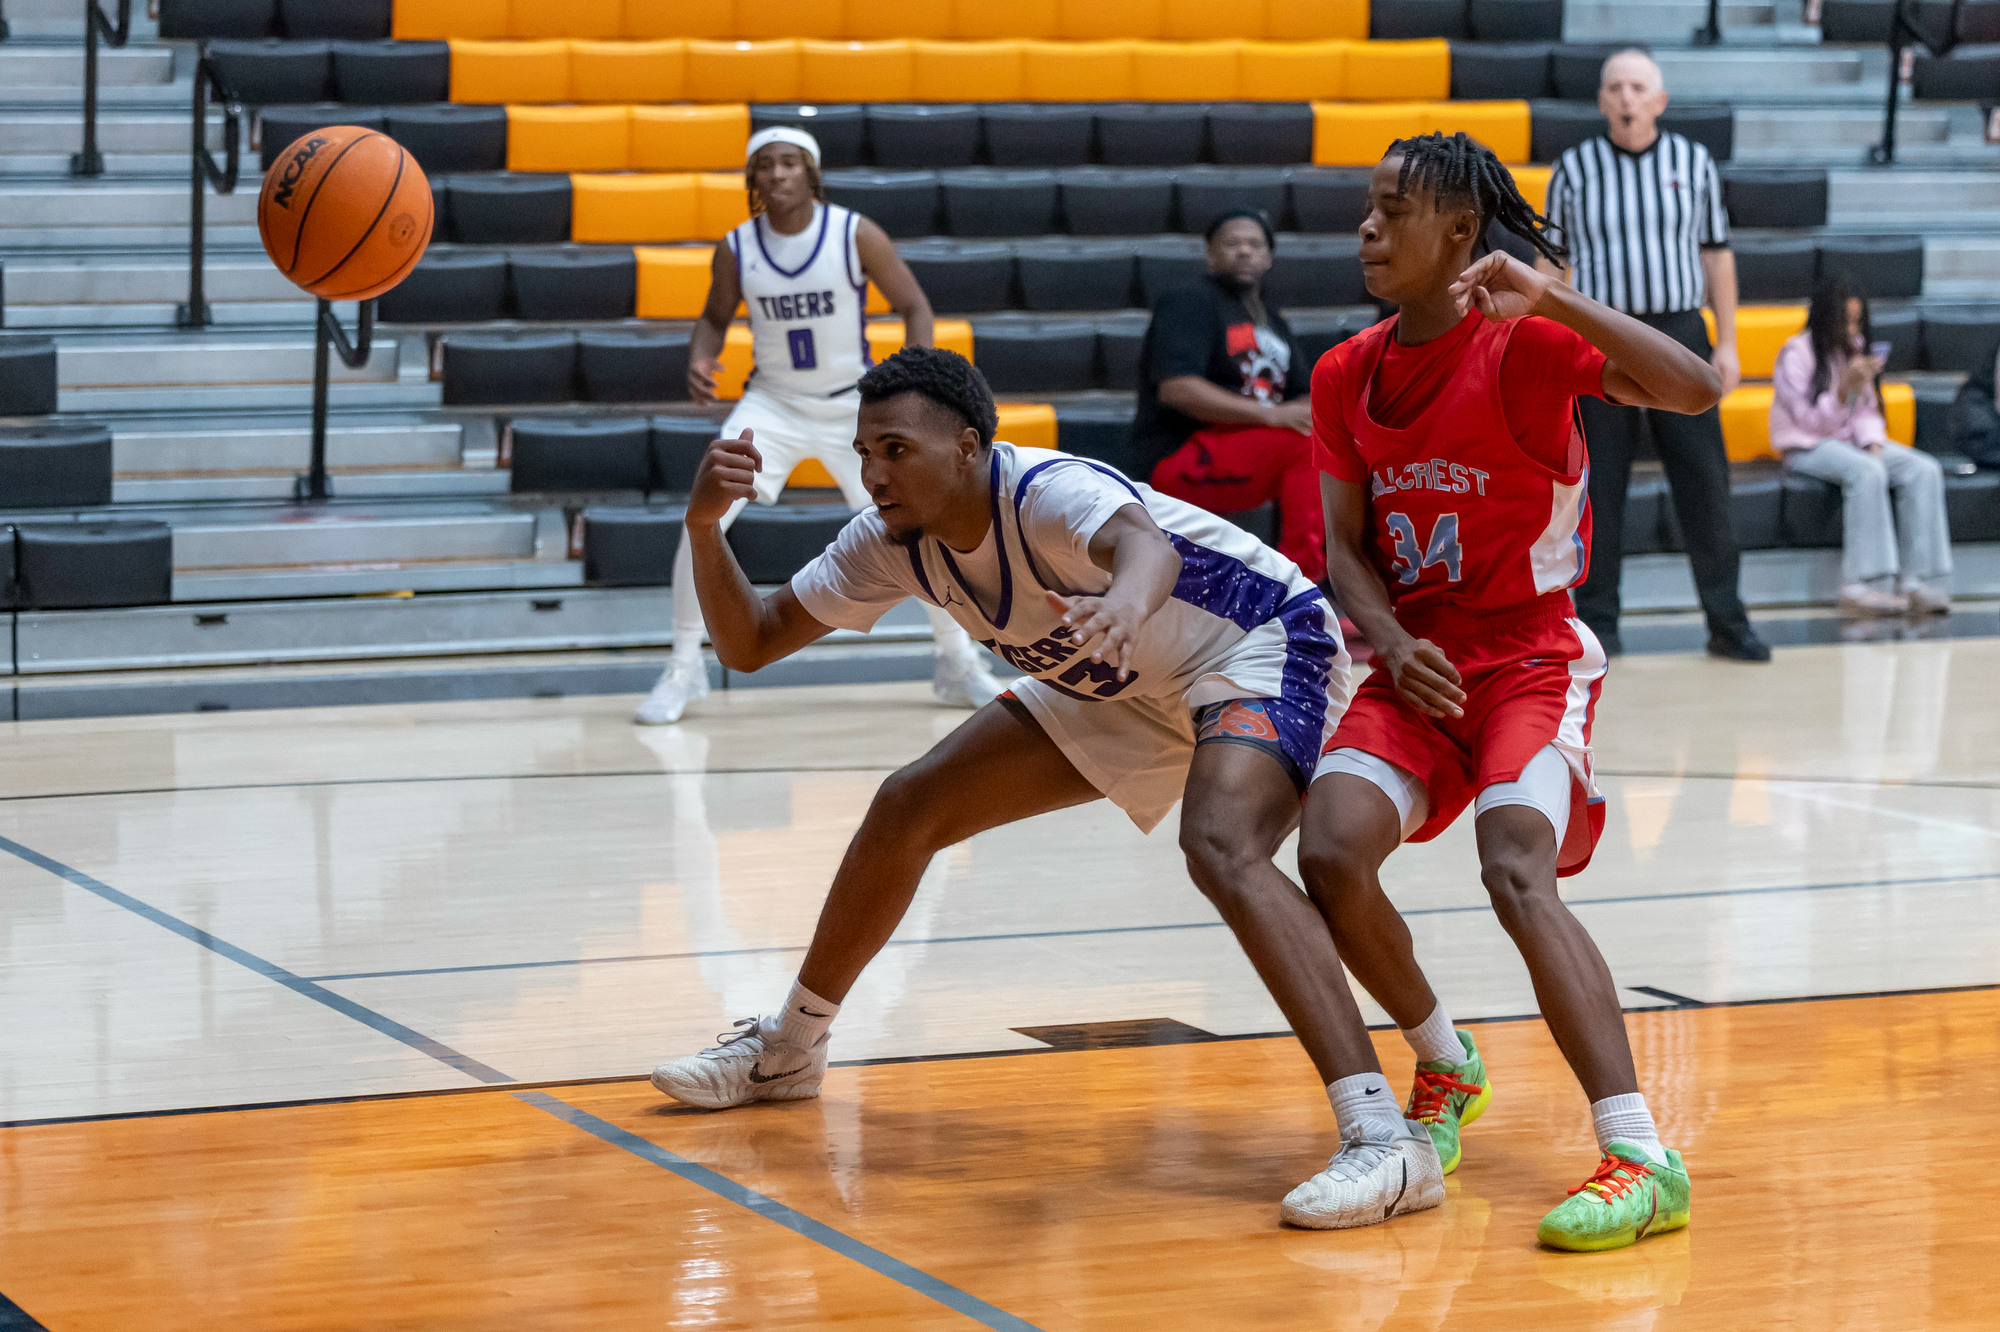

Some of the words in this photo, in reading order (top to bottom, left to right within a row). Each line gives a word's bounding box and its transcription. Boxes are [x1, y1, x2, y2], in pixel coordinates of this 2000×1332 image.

[274, 138, 328, 210] NCAA
[757, 290, 834, 320] TIGERS
[788, 329, 817, 370] 0
[1386, 511, 1463, 585] 34
